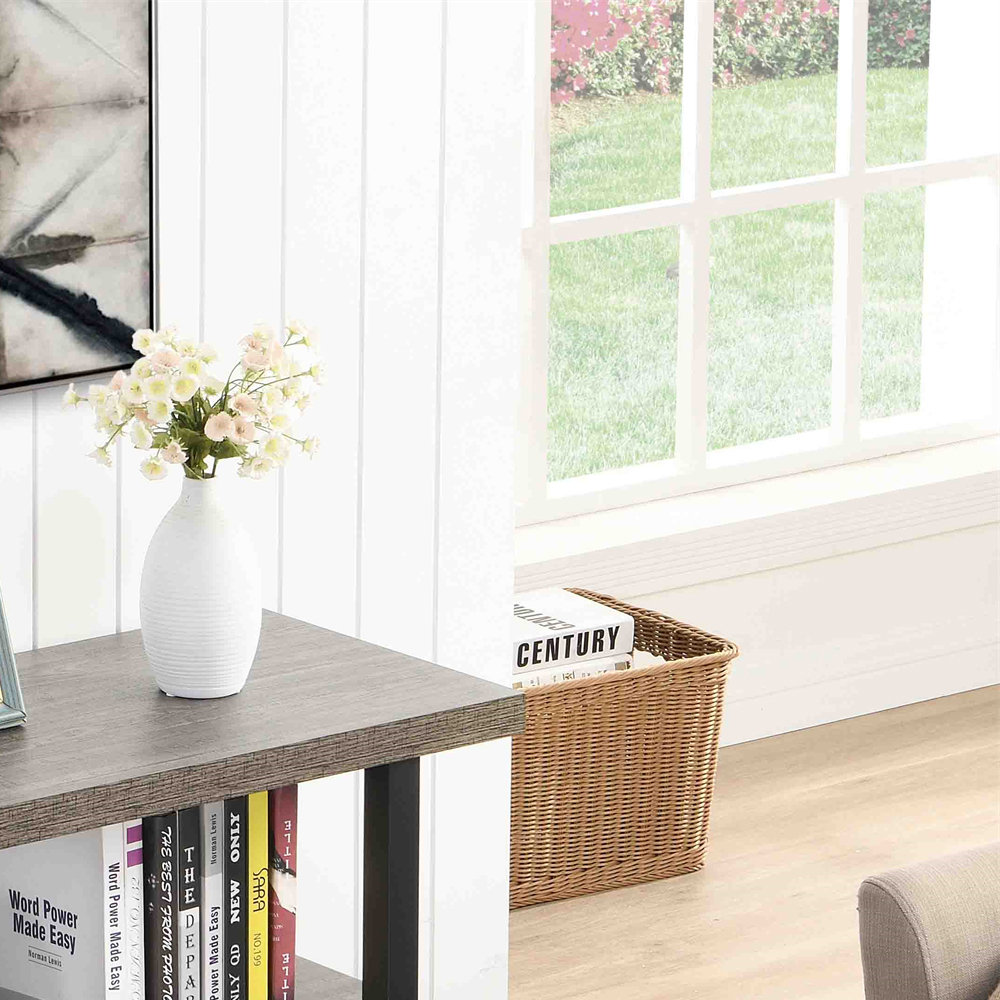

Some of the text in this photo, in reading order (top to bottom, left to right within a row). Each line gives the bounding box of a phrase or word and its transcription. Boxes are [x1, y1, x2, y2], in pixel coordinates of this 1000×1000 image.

[517, 626, 620, 668] CENTURY
[161, 826, 172, 857] THE
[230, 812, 240, 863] ONLY
[161, 861, 172, 902] BEST
[183, 846, 196, 904] THE
[253, 867, 268, 912] SARA
[8, 889, 78, 929] Word Power
[209, 906, 220, 932] Easy
[230, 880, 240, 924] NEW
[13, 913, 76, 955] Made Easy
[108, 862, 122, 991] Word Power Made Easy
[161, 905, 173, 951] FROM
[28, 949, 62, 967] Norman Lewis
[209, 934, 219, 965] Made
[253, 932, 262, 967] NO.199
